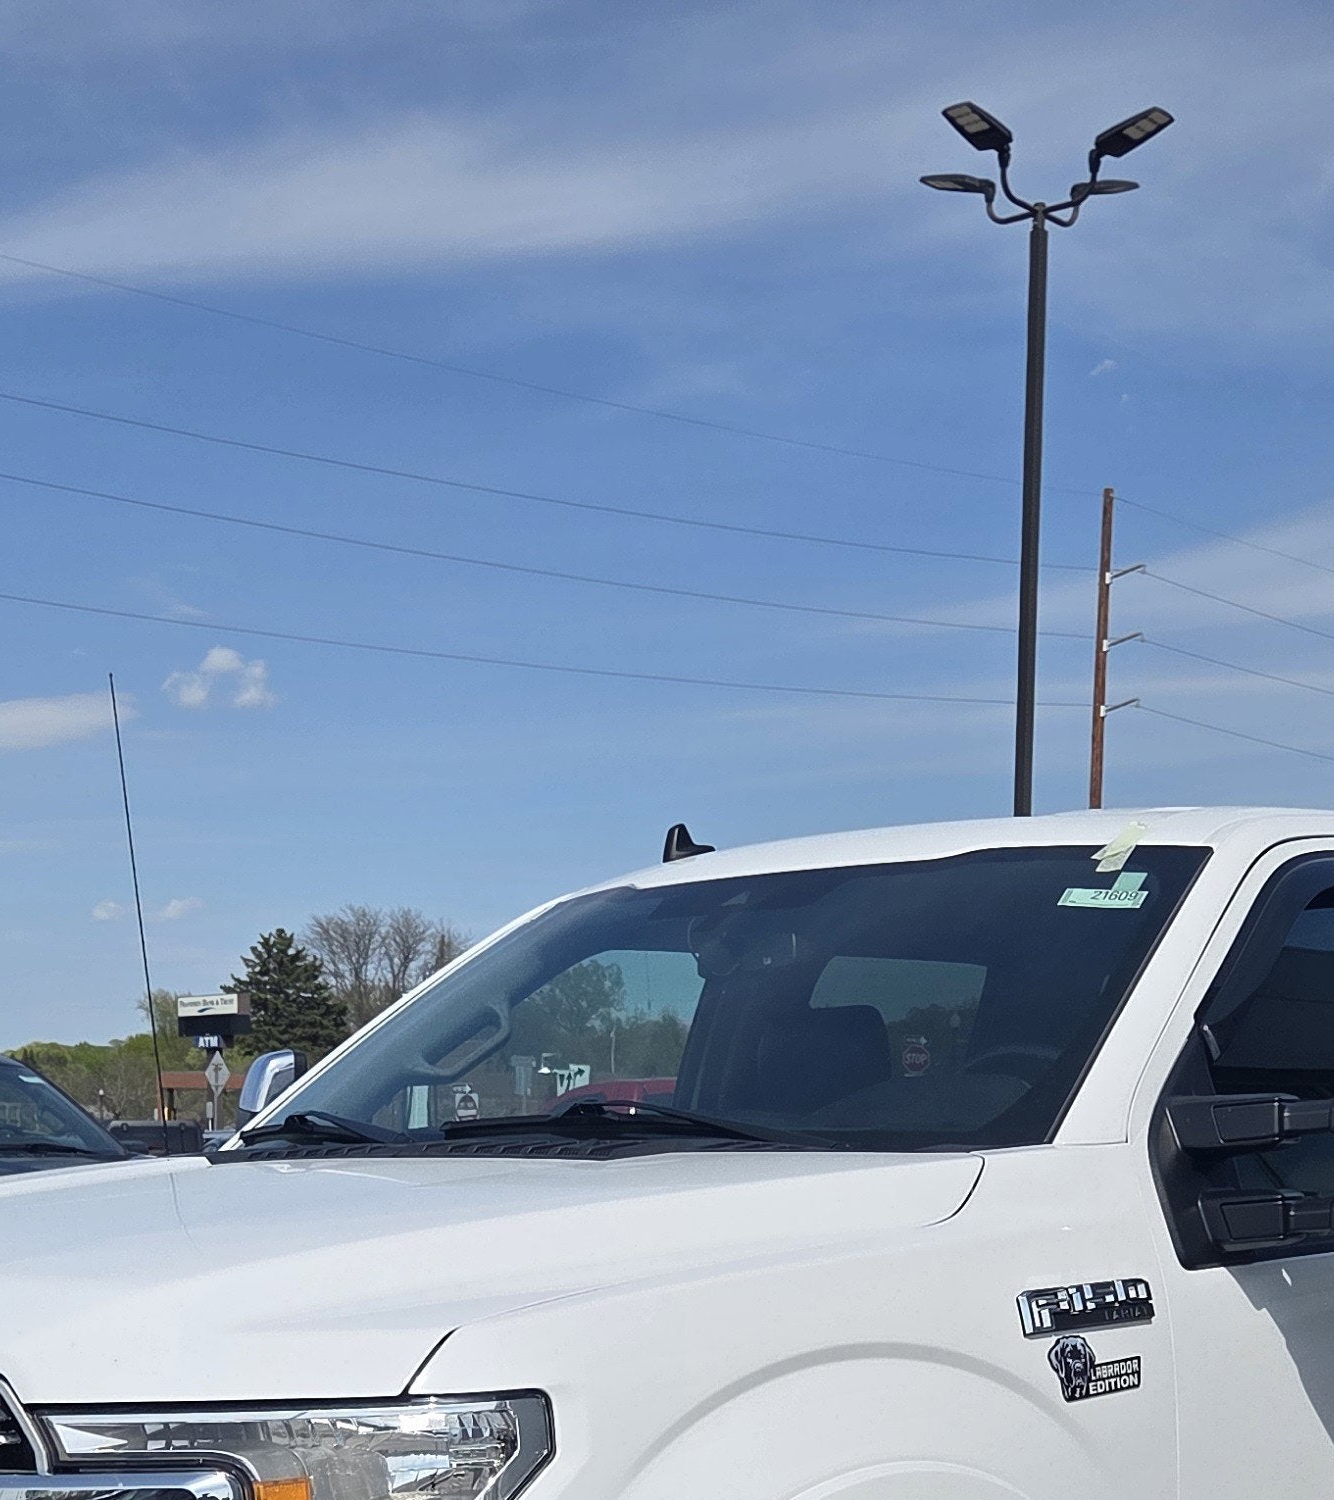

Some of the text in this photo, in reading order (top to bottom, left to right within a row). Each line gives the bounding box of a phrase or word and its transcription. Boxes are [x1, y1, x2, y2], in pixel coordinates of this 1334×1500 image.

[1090, 890, 1139, 901] 21609
[198, 1036, 218, 1047] ATM
[1090, 1359, 1140, 1381] LABRADOR
[1088, 1373, 1139, 1395] EDITION
